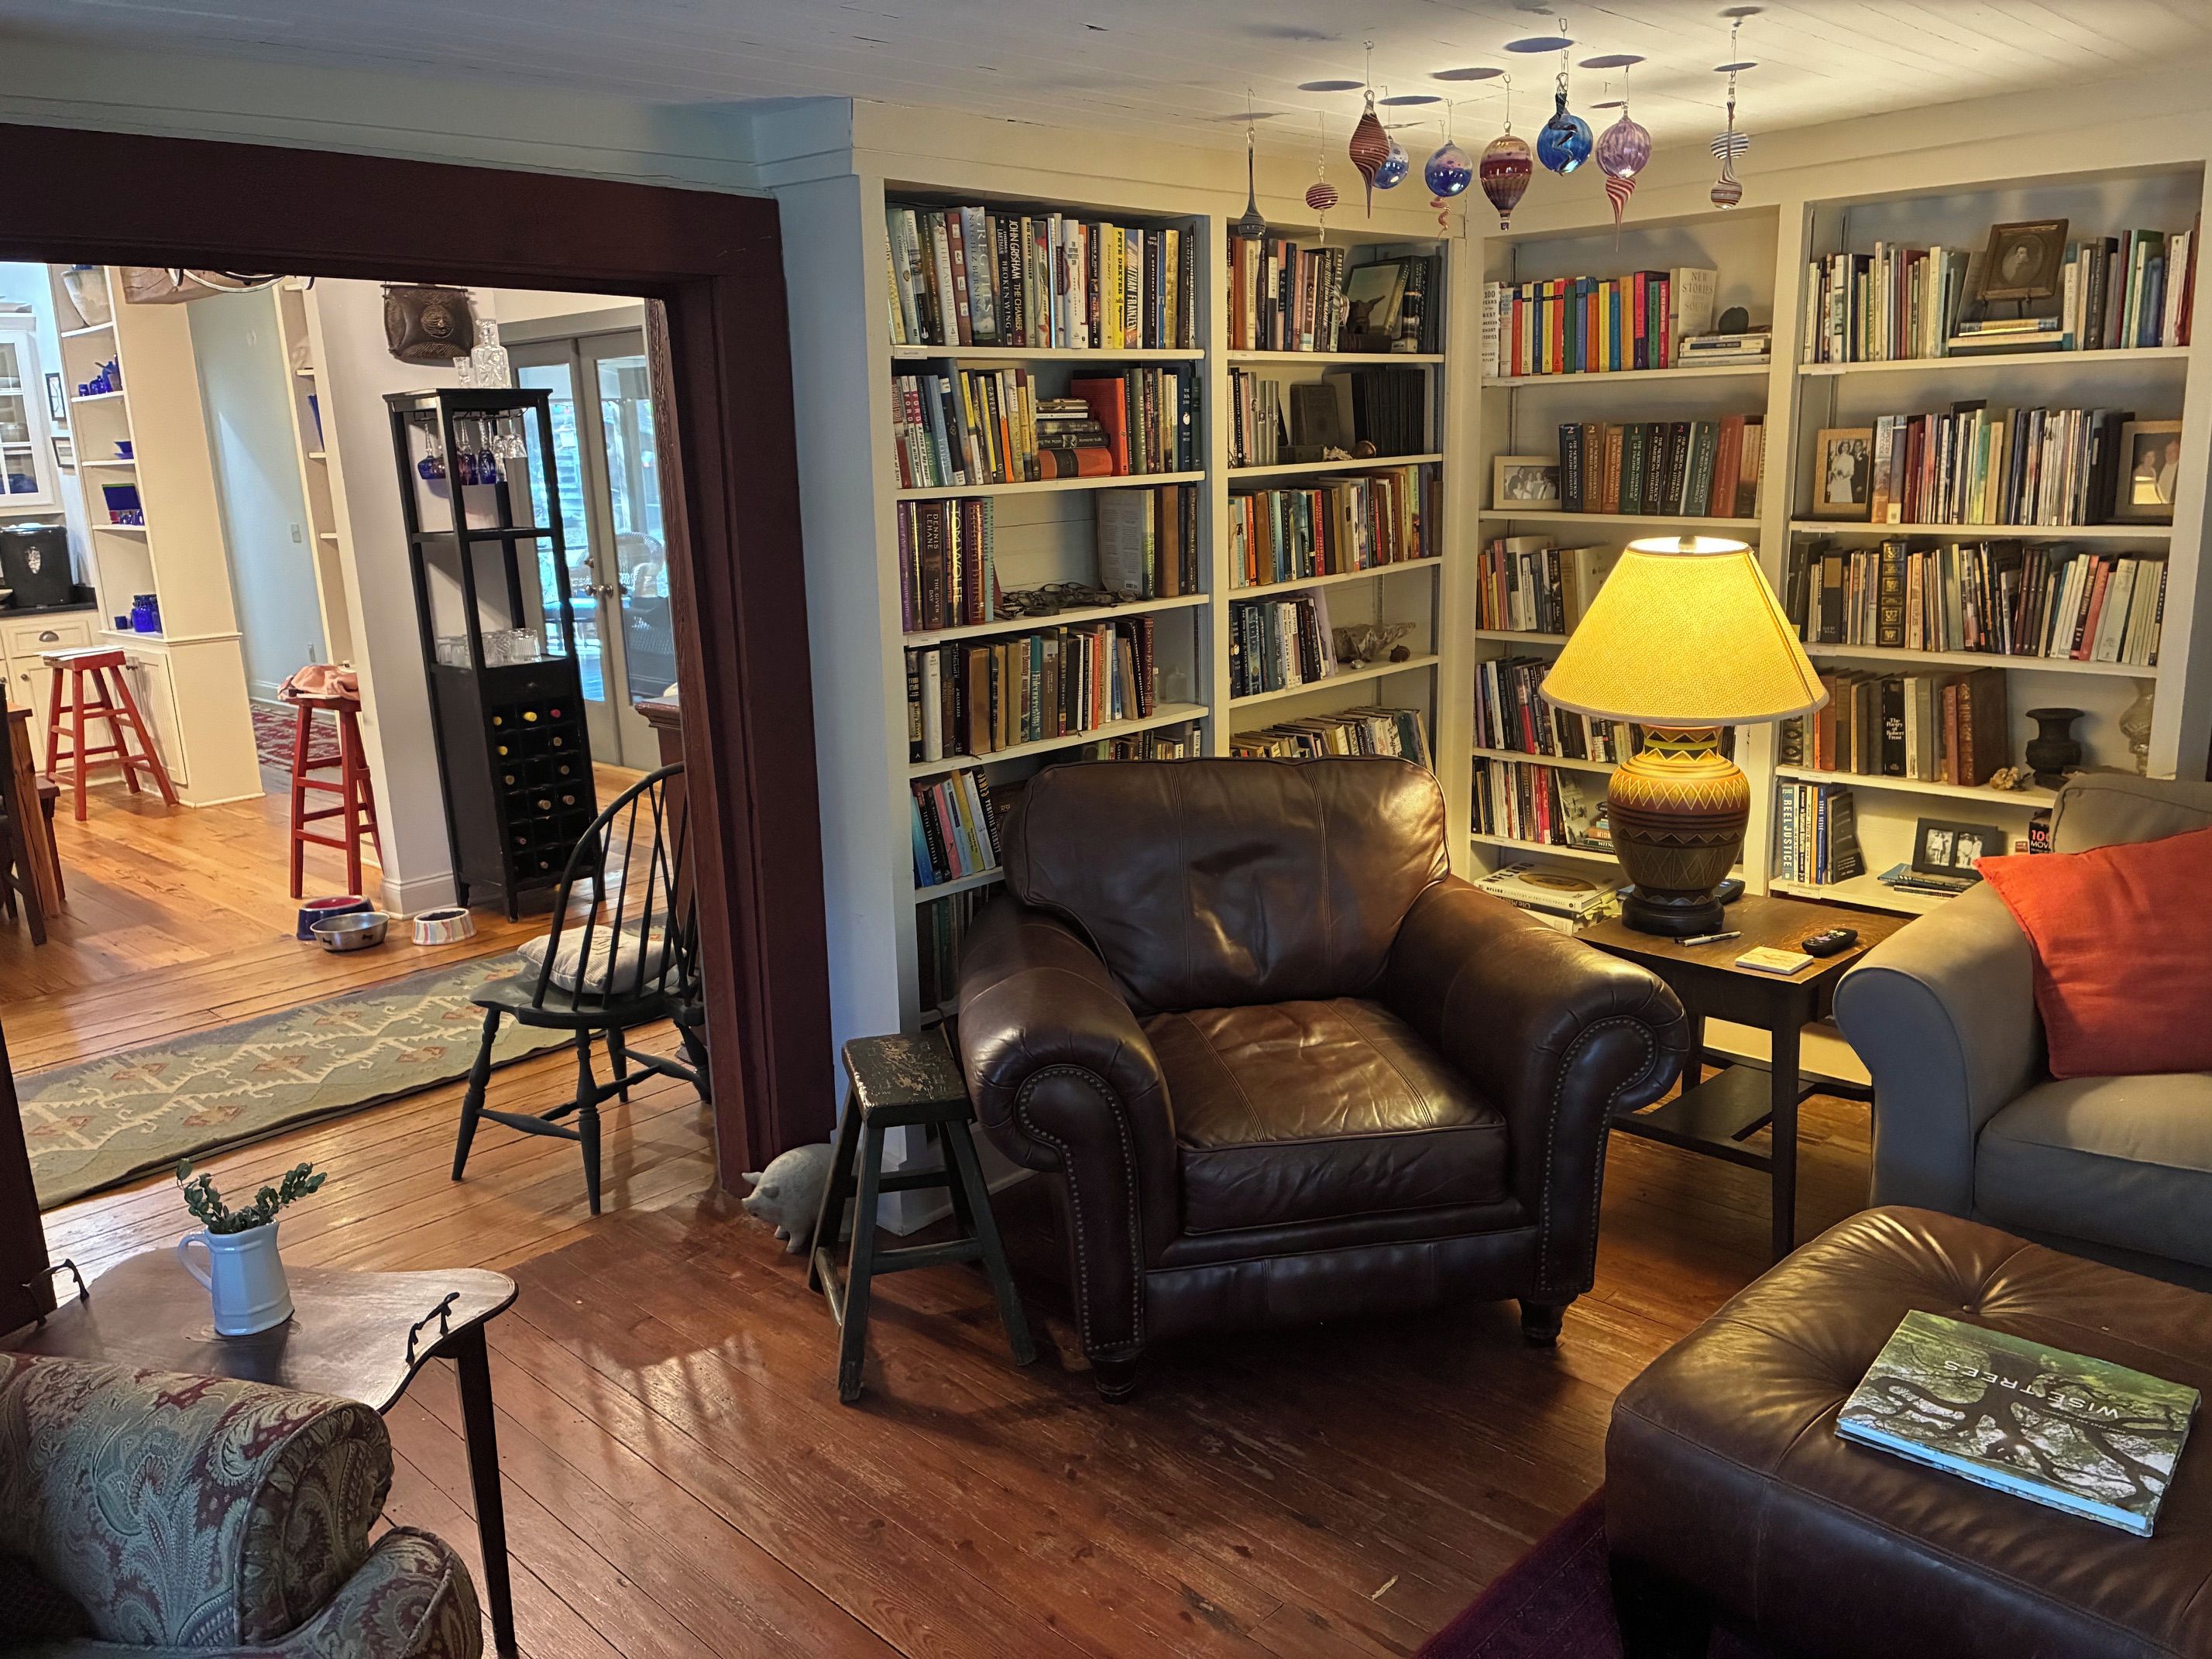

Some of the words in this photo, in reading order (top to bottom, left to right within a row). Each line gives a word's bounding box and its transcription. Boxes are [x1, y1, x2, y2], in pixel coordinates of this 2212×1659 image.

[969, 215, 977, 263] NATCHEZ
[976, 213, 989, 266] GREG
[1008, 220, 1019, 242] JOHN
[1009, 243, 1022, 279] GRISHAM
[1127, 248, 1138, 292] JONATHAN
[1692, 272, 1709, 281] NEW
[1682, 283, 1713, 295] STORIES
[1126, 294, 1137, 331] FRANZEN
[904, 393, 912, 422] FORD
[912, 393, 921, 424] FORD
[988, 386, 996, 415] CAVEAT
[951, 507, 960, 542] TOM
[953, 547, 963, 603] WOLFE
[977, 773, 990, 797] JAMES
[984, 799, 996, 826] PERCIVAL
[991, 828, 1001, 854] EVERETT
[1783, 799, 1792, 823] REEL
[1783, 826, 1792, 867] JUSTICE
[1942, 1358, 2035, 1396] TREES
[2047, 1389, 2121, 1421] WISE
